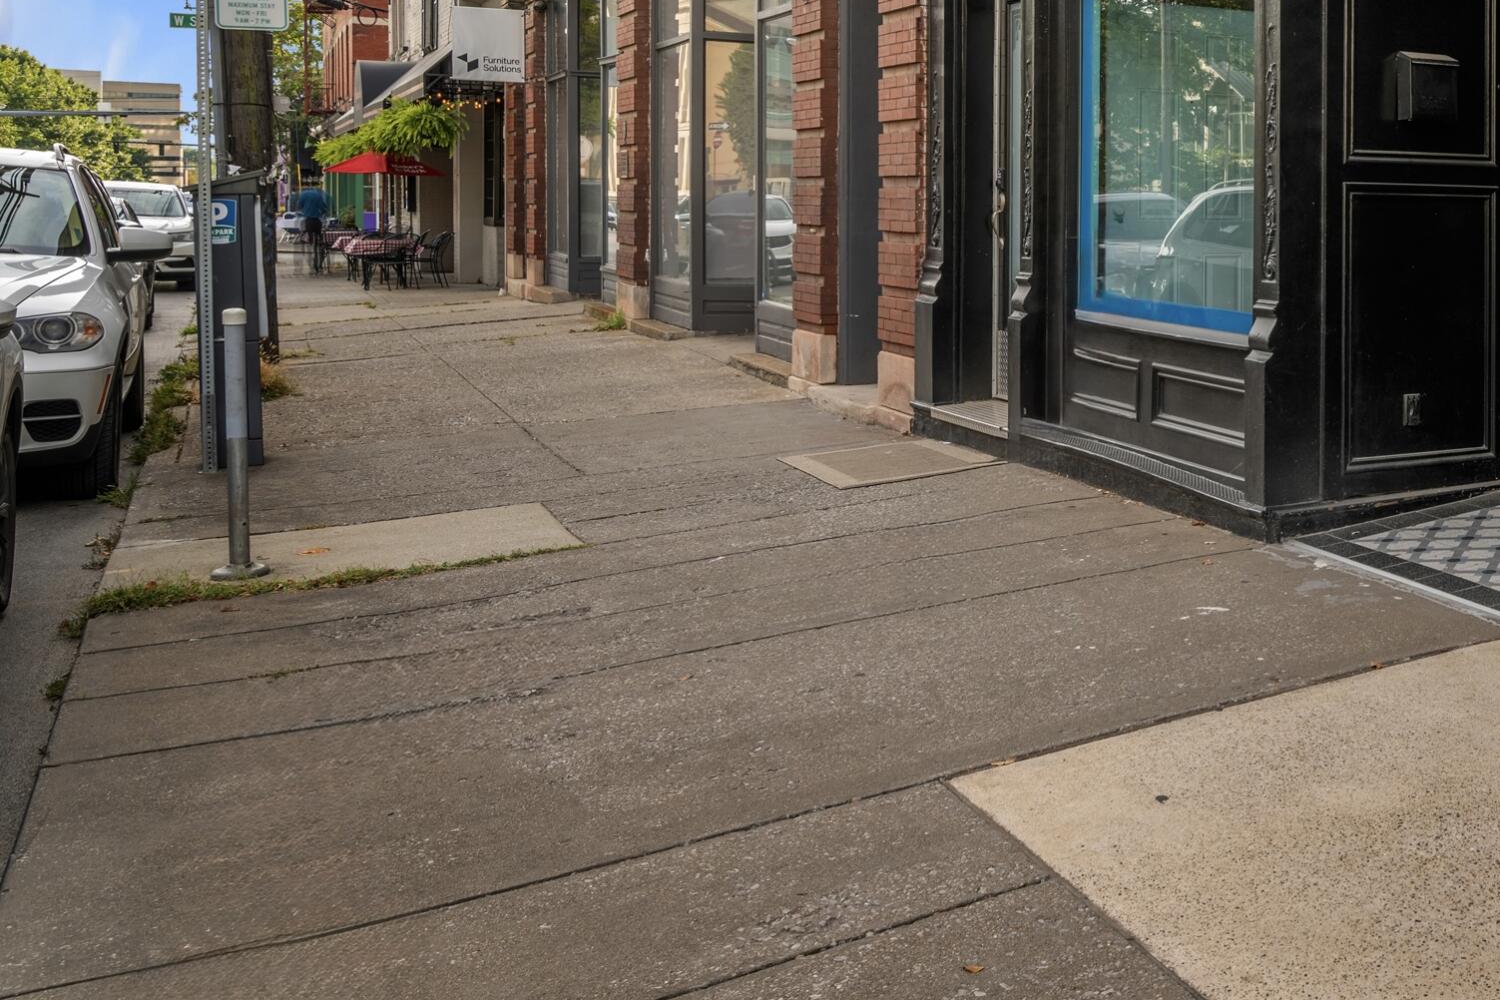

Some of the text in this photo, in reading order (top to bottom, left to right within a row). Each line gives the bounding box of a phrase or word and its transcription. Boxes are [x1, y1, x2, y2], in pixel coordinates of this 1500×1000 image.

[174, 15, 184, 26] W
[483, 56, 520, 65] Furniture
[483, 64, 521, 73] Solutions
[211, 202, 228, 226] P
